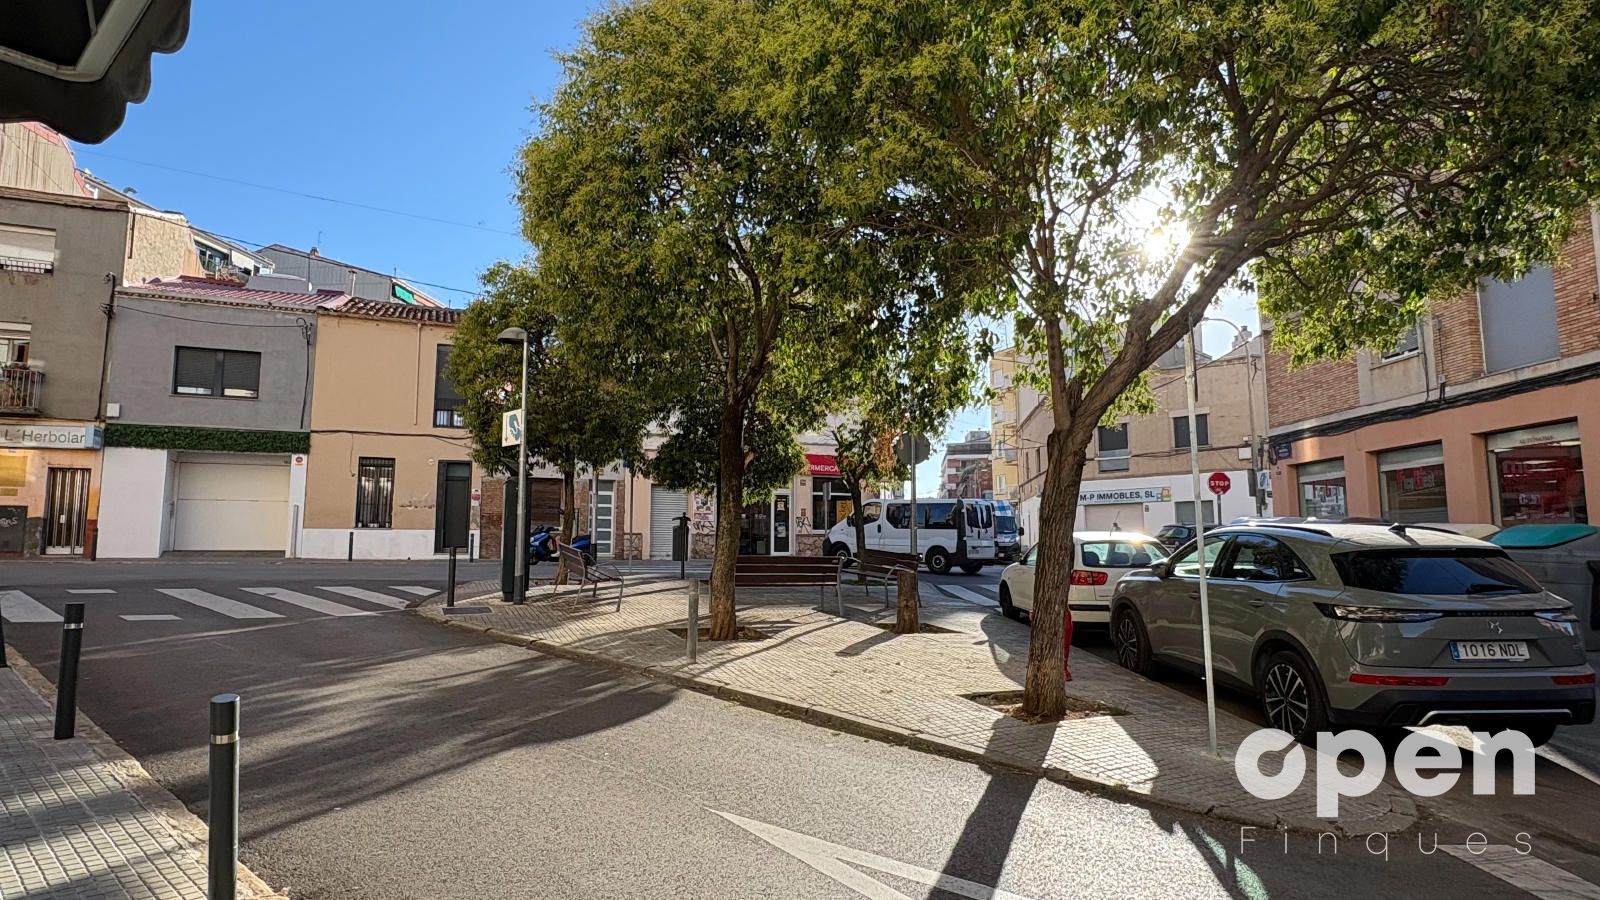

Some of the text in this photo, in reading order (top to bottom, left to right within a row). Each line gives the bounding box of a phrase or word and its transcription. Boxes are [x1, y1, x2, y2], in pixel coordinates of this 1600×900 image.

[807, 464, 839, 472] ERMERCA
[1096, 491, 1142, 500] IMMOBLES,
[1462, 643, 1525, 657] 1016 NDL
